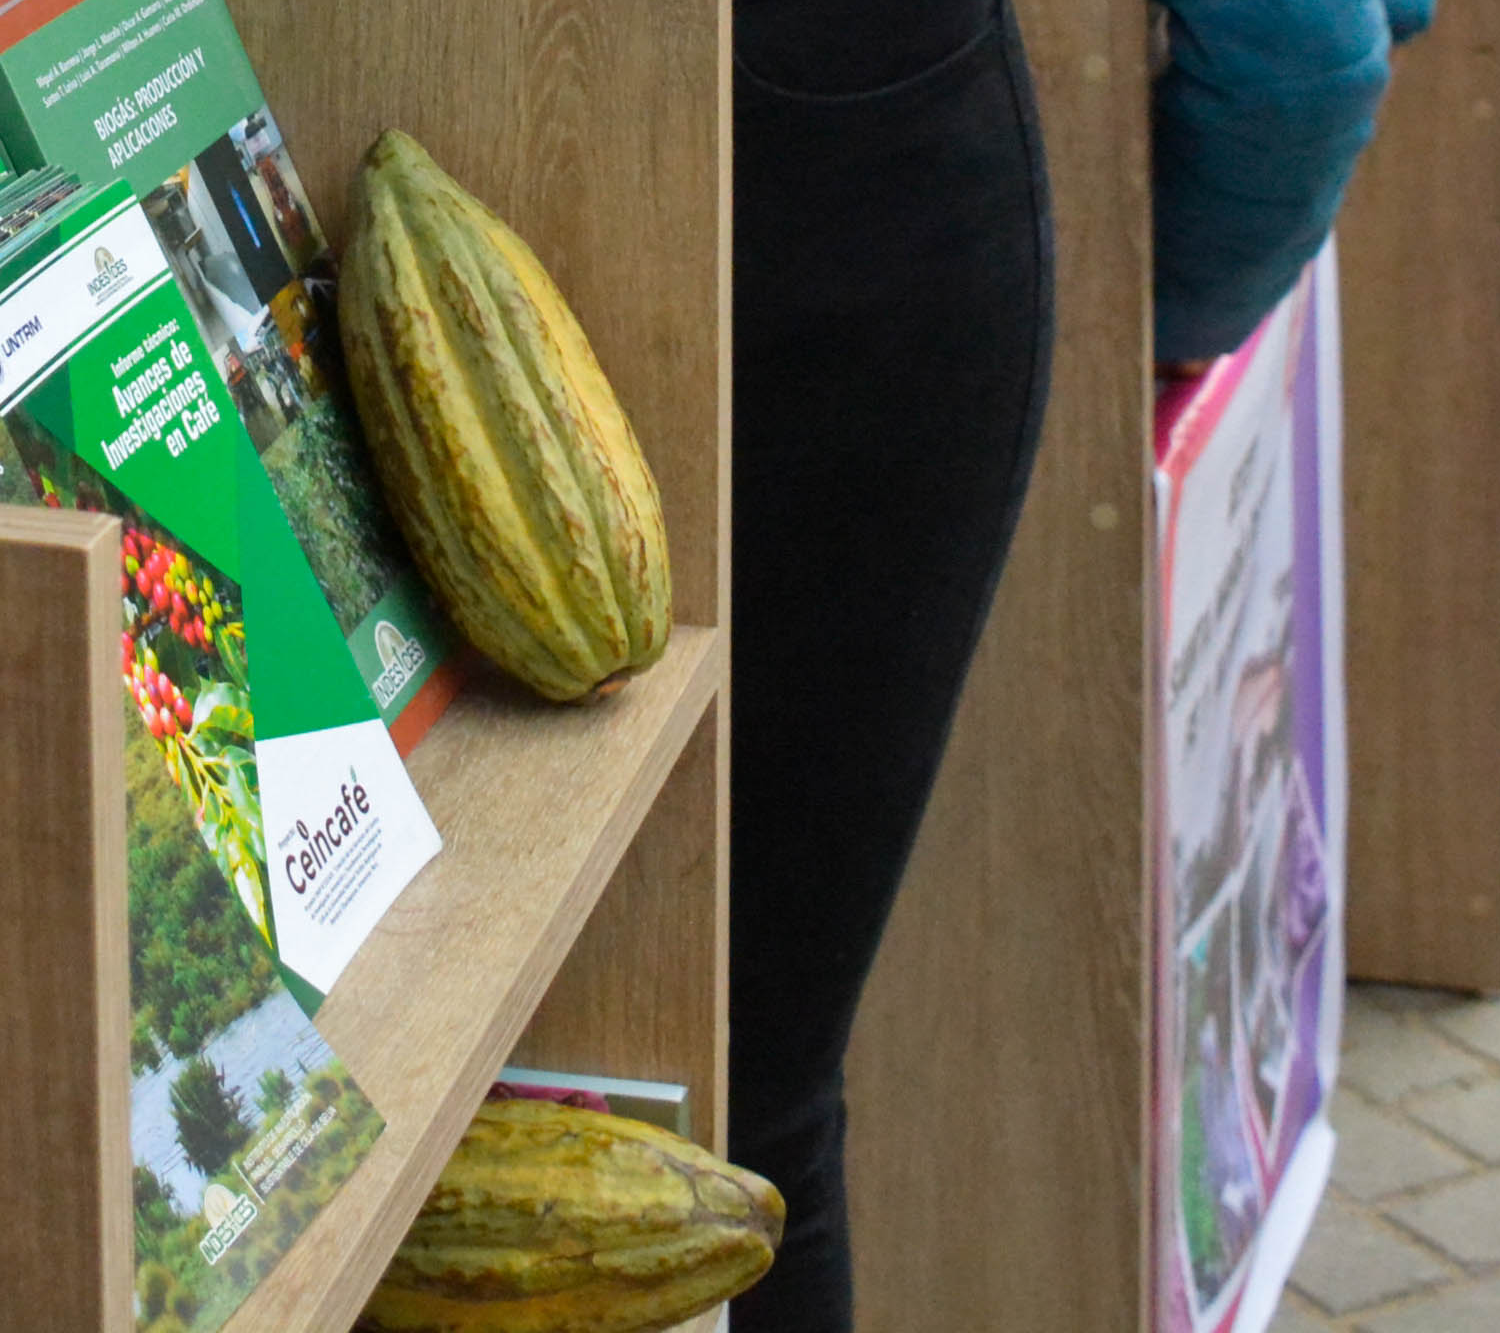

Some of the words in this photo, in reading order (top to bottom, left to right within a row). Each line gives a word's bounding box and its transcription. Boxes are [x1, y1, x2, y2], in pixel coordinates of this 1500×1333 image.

[93, 96, 140, 141] BIOGÁS:
[133, 52, 200, 114] PRODUCCIÓN
[192, 46, 206, 69] Y
[107, 103, 178, 170] APLICACIONES
[1, 314, 43, 358] UNTRM
[110, 345, 146, 379] Informe
[141, 318, 181, 354] técnico:
[112, 356, 173, 419] Avances
[169, 339, 193, 370] de
[100, 370, 207, 471] Investigaciones
[165, 427, 188, 458] en
[180, 393, 220, 441] Café
[285, 765, 371, 895] Ceincafé
